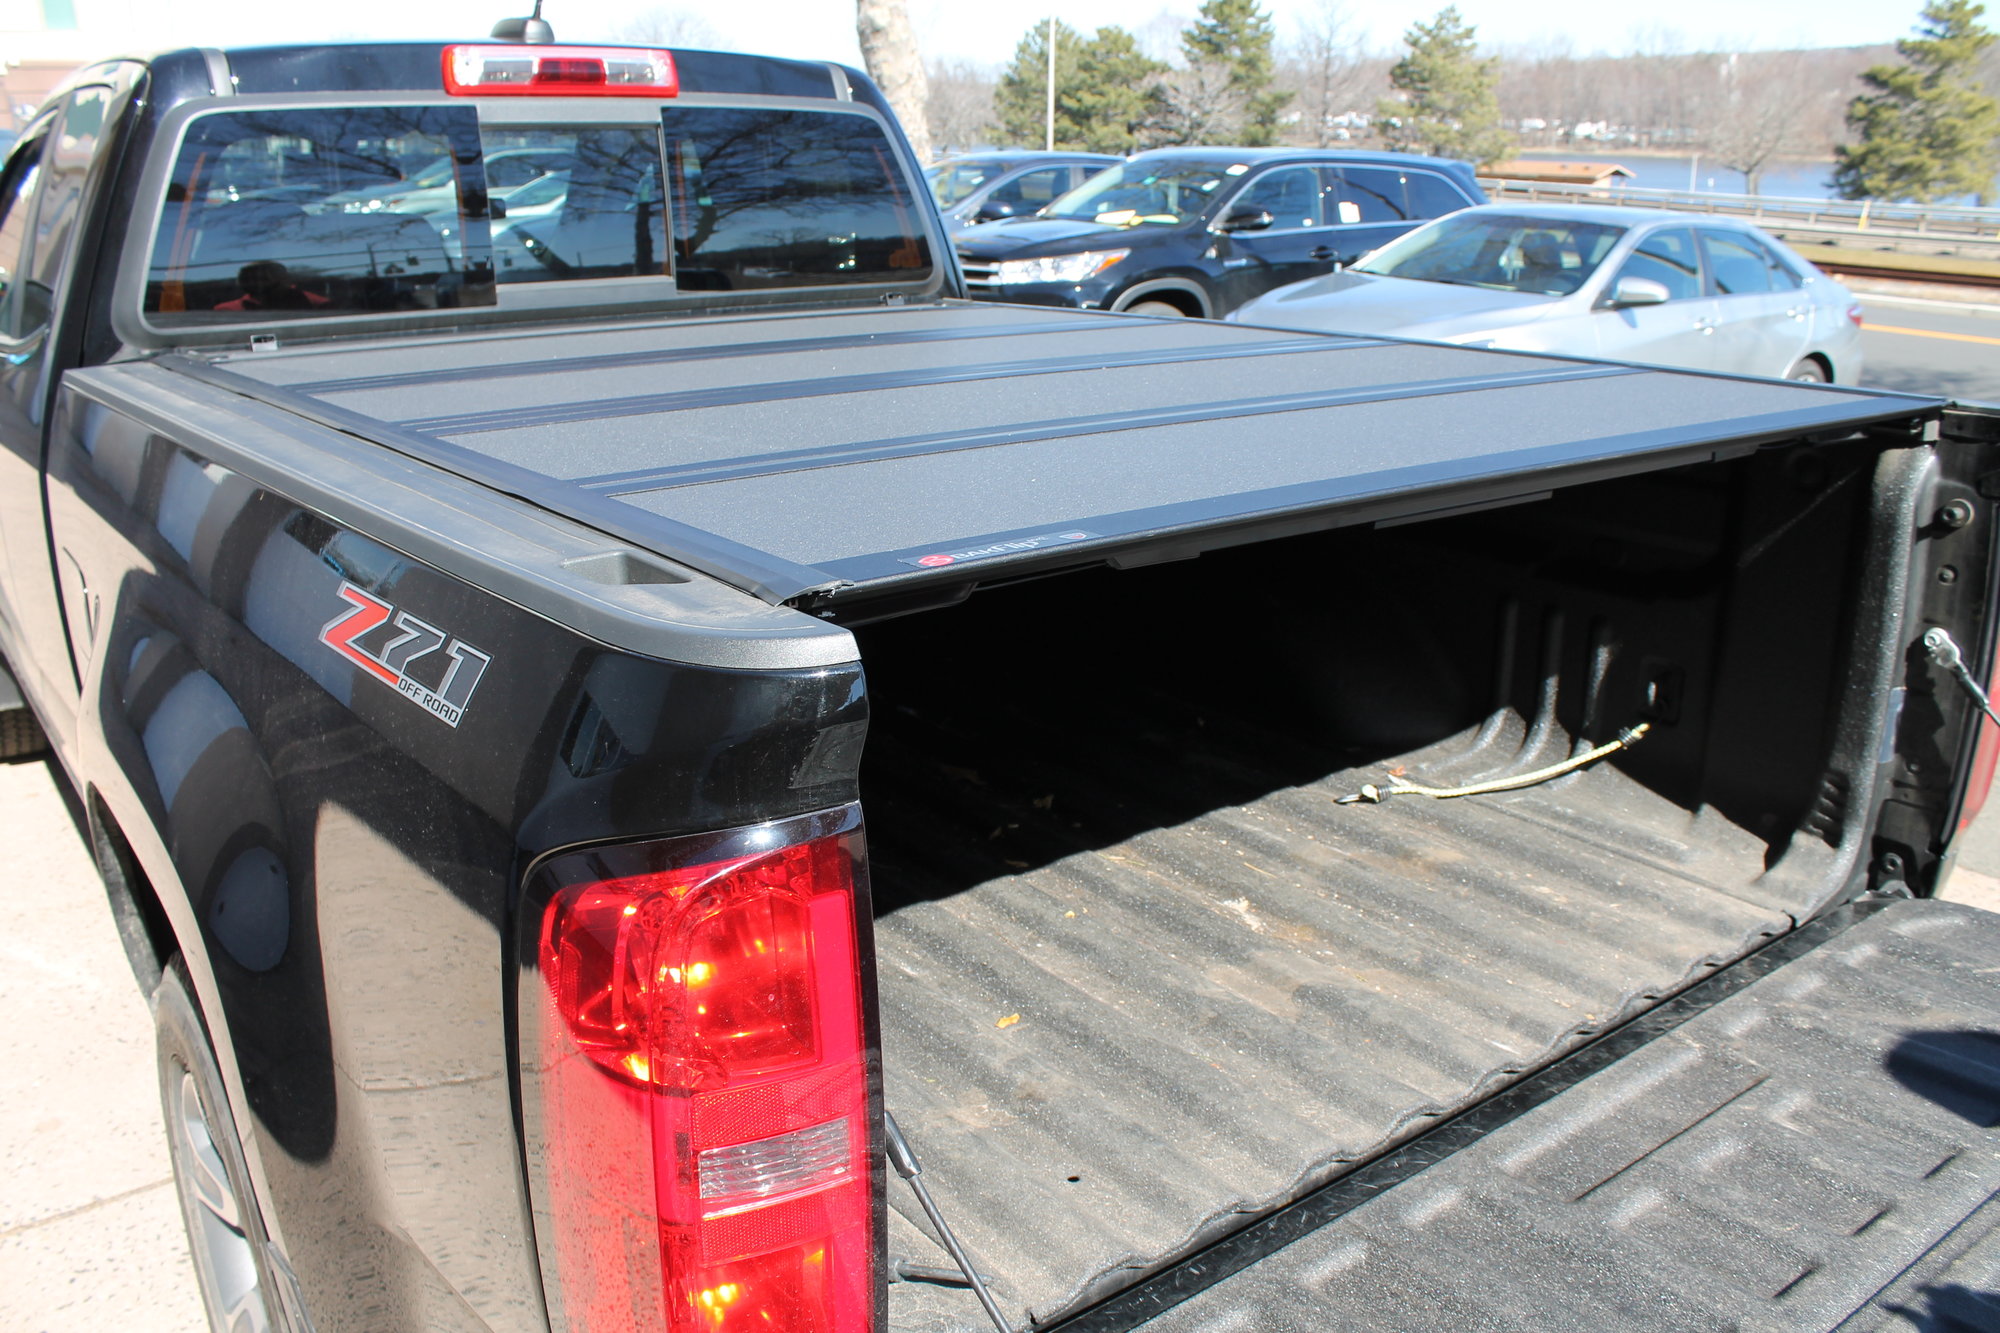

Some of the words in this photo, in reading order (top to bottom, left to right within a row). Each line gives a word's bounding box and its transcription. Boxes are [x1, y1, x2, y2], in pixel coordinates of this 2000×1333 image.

[319, 580, 494, 711] Z71
[398, 678, 421, 698] OFF
[422, 693, 460, 724] ROAD
